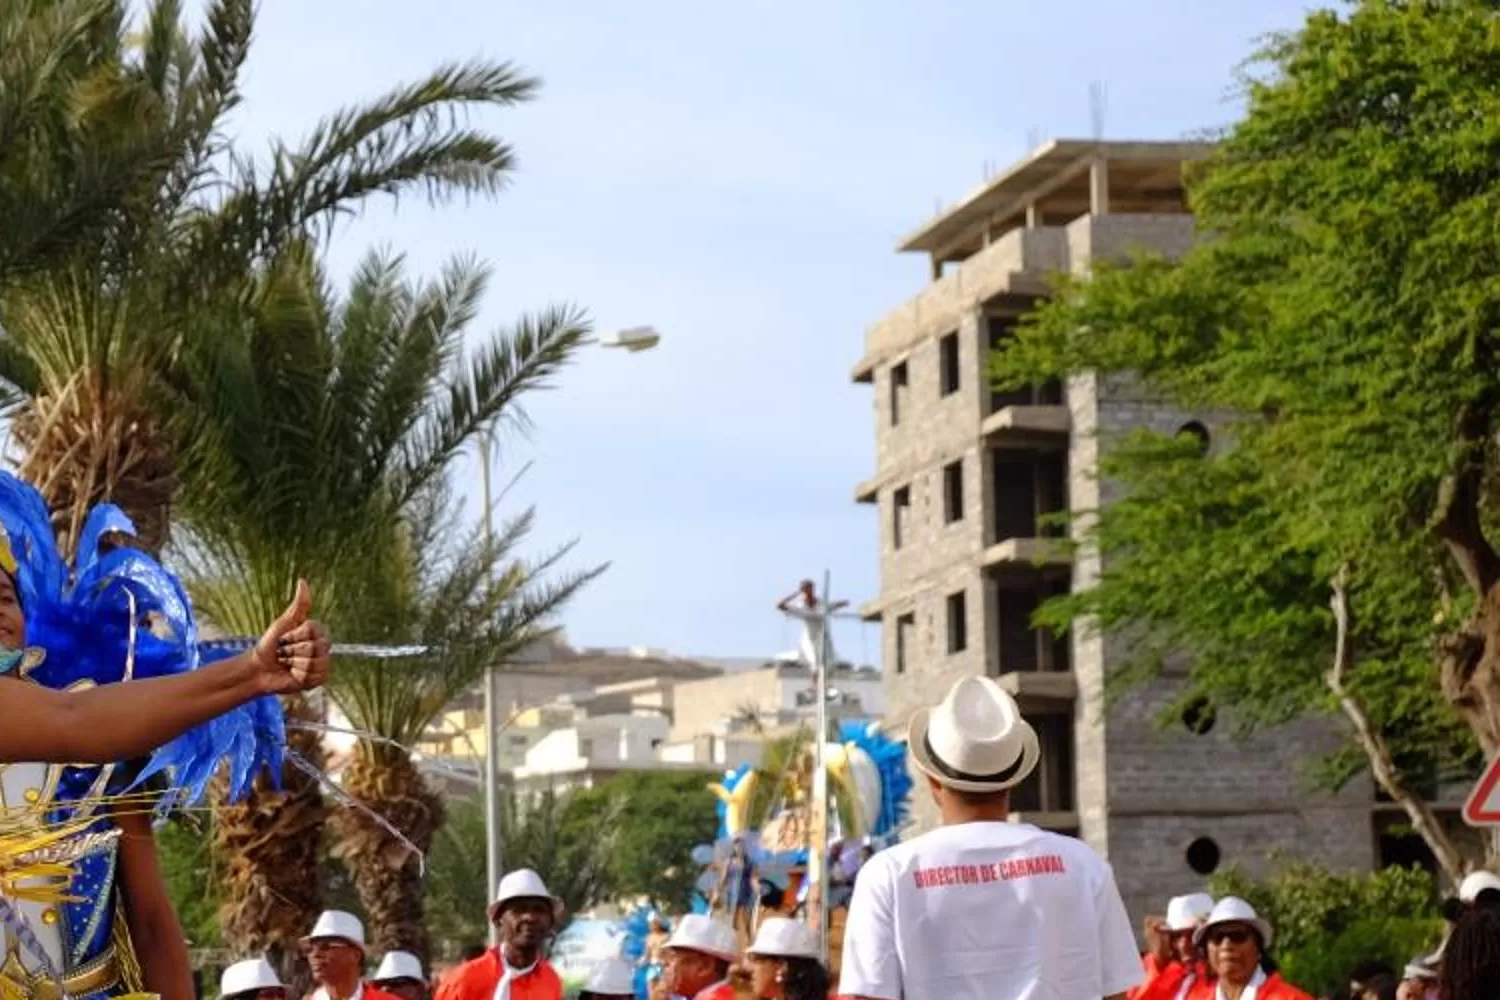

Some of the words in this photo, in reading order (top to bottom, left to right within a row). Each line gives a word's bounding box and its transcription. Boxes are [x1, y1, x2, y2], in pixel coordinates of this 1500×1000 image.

[913, 865, 978, 888] DIRECTOR
[980, 863, 998, 882] DE
[1000, 855, 1065, 879] CARNAVAL
